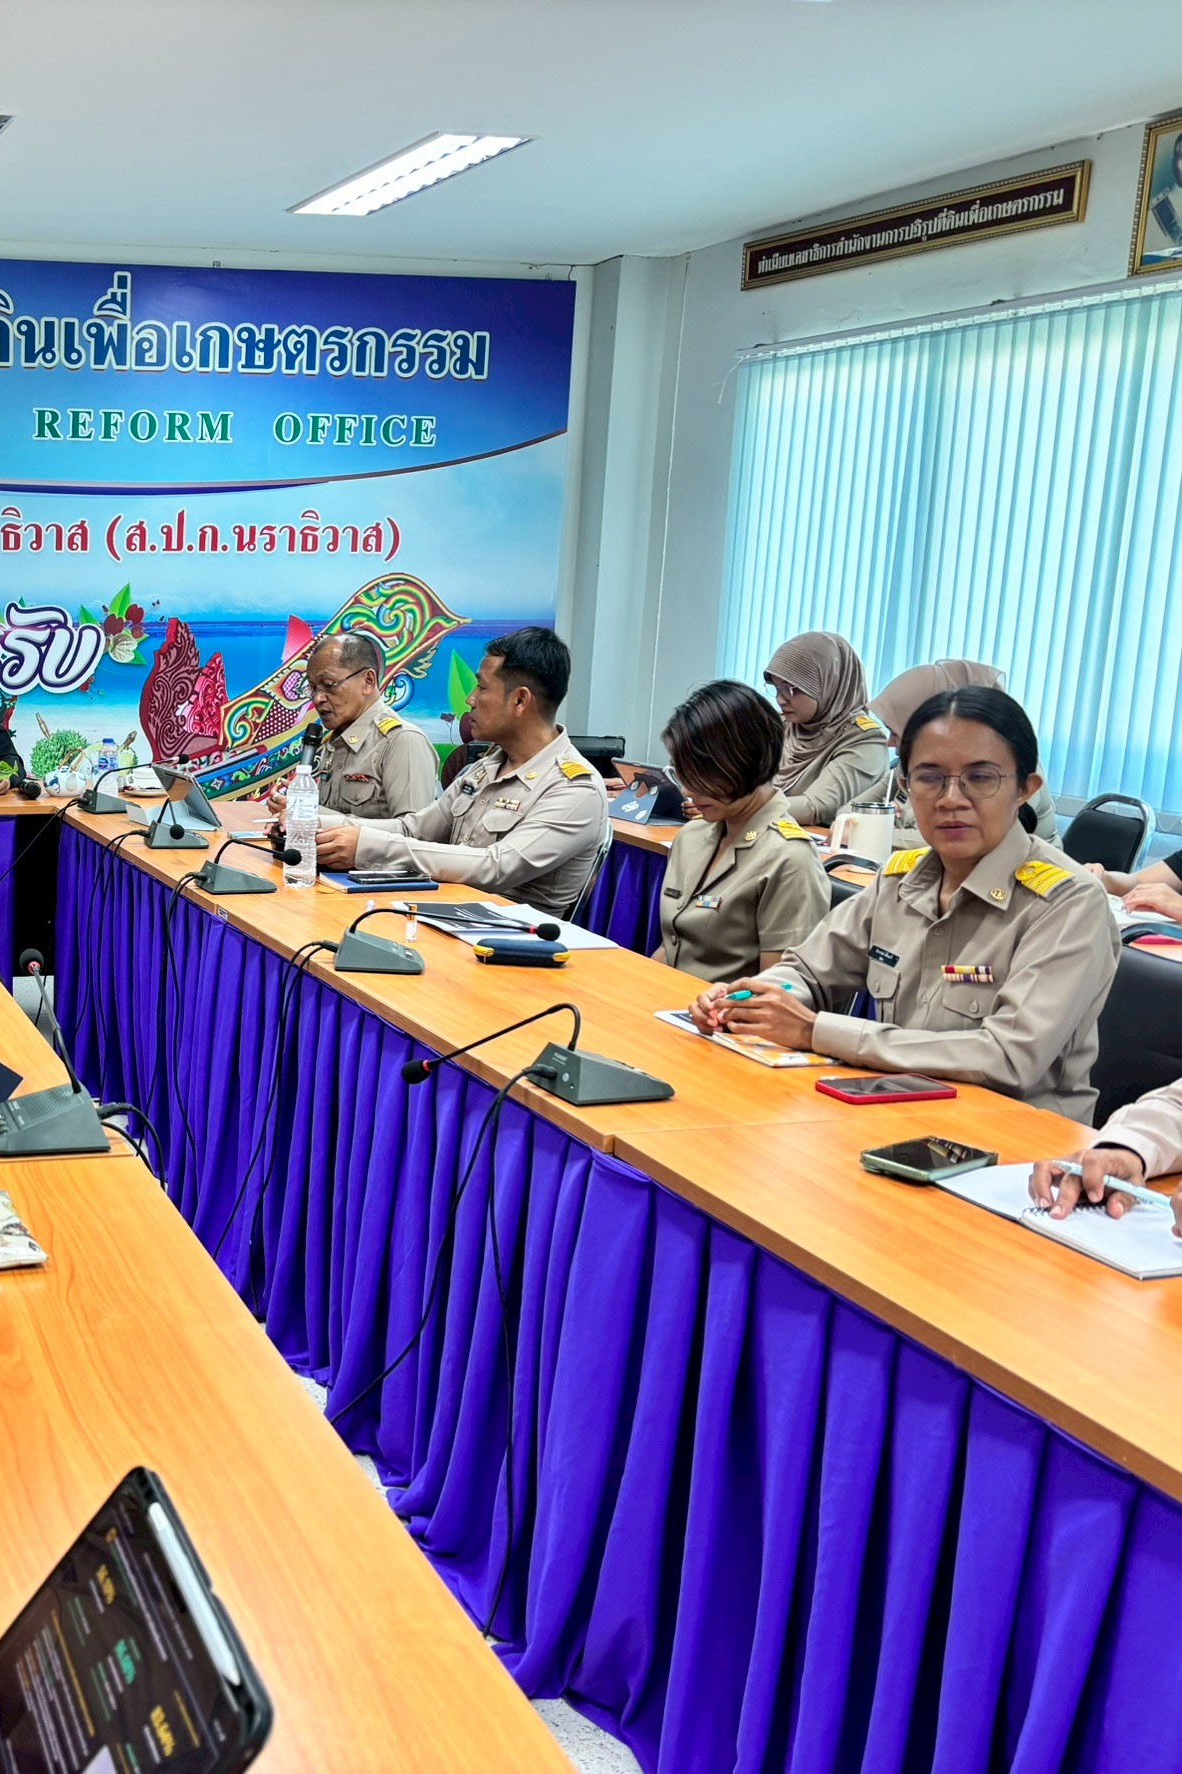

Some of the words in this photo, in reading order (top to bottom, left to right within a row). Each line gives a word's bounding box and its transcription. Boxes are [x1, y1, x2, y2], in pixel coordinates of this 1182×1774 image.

[34, 408, 233, 444] REFORM
[274, 413, 436, 448] OFFICE
[105, 508, 401, 563] (ส.ป.ก.นราธิวาส)
